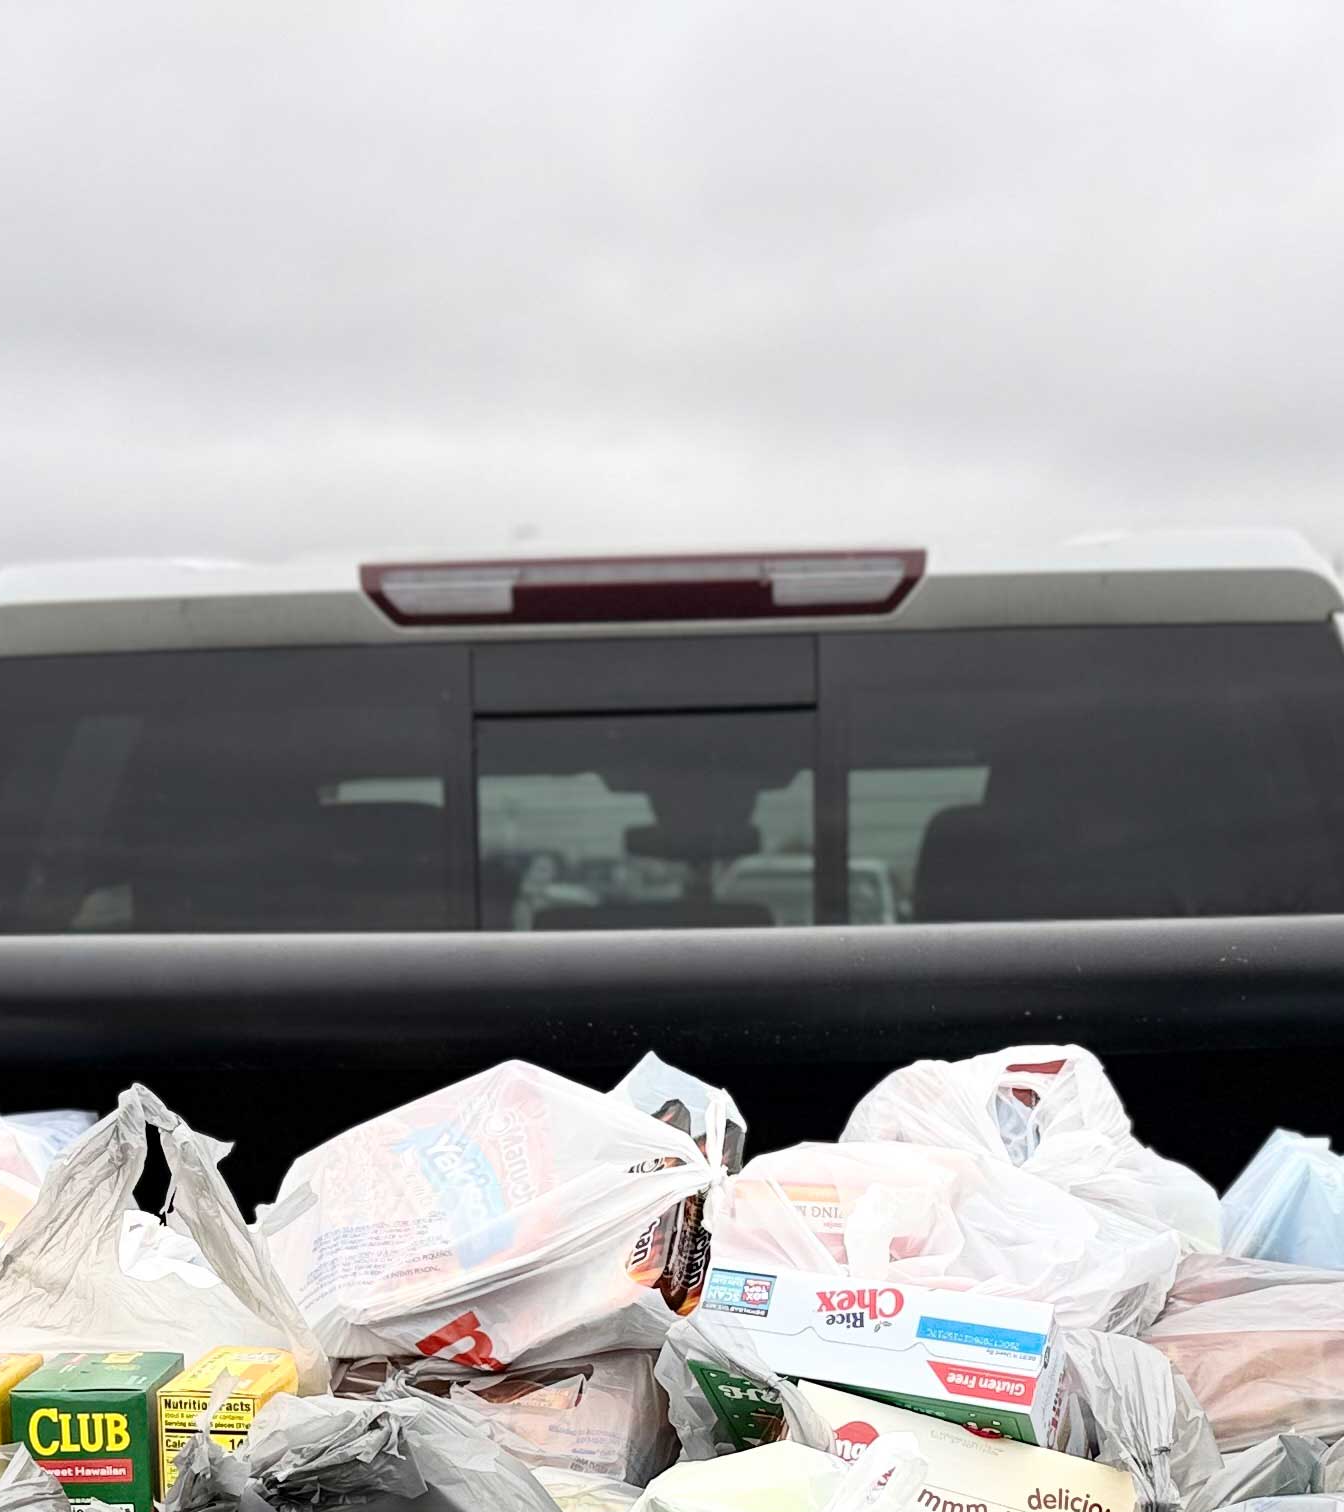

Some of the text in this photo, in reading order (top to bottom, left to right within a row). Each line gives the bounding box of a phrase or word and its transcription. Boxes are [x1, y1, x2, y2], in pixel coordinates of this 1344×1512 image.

[816, 1288, 904, 1320] Chex
[826, 1312, 864, 1329] Rice
[947, 1372, 1025, 1396] Gluten Free
[29, 1408, 131, 1456] CLUB
[75, 1465, 127, 1478] Hawaiian
